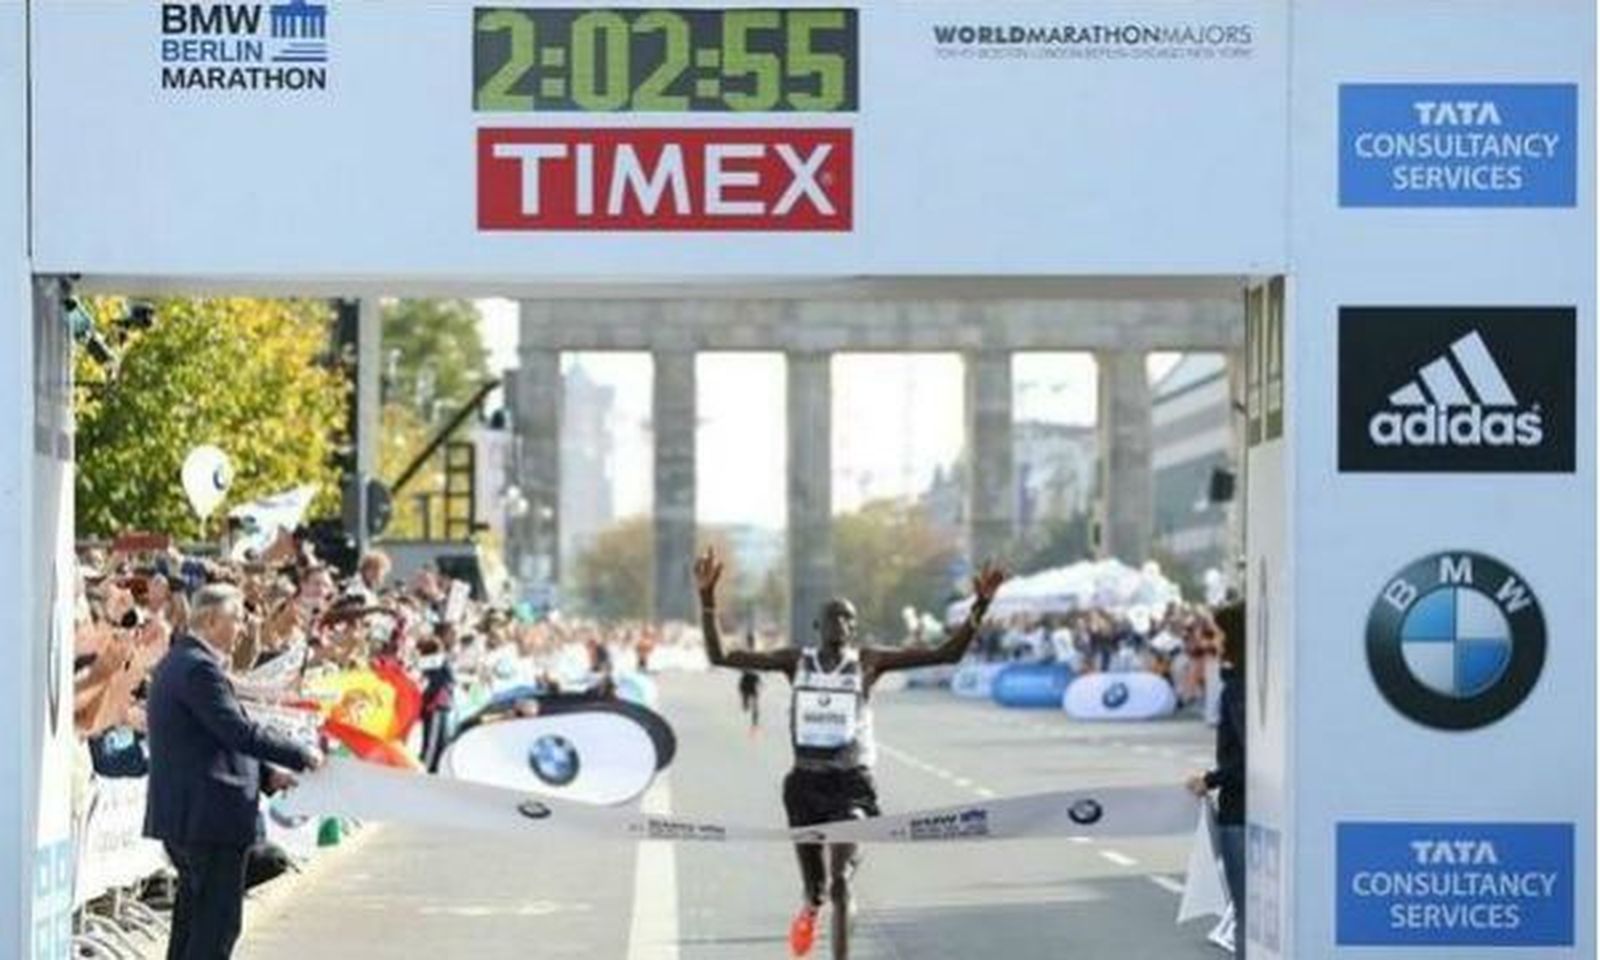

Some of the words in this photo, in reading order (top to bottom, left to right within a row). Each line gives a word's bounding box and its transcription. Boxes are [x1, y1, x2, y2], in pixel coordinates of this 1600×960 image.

[161, 3, 262, 35] BMW
[161, 39, 264, 63] BERLIN
[477, 10, 846, 111] 2:02:55
[161, 67, 327, 91] MARATHON
[1414, 101, 1502, 126] TATA
[1354, 132, 1560, 159] CONSULTANCY
[493, 143, 836, 216] TIMEX
[1393, 165, 1524, 191] SERVICES
[1368, 404, 1544, 446] adidas
[1383, 555, 1532, 613] BMW
[1410, 840, 1499, 865] TATA
[1352, 872, 1557, 897] CONSULTANCY
[1390, 903, 1522, 930] SERVICES
